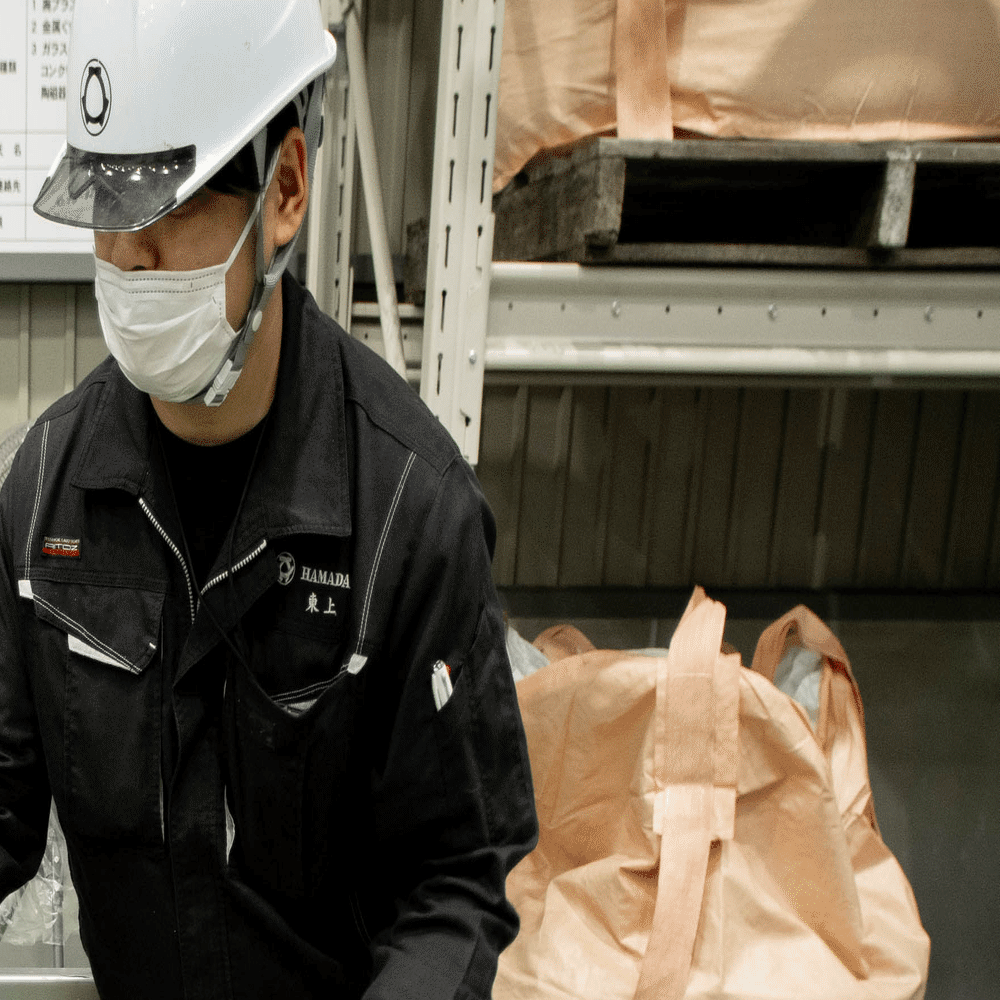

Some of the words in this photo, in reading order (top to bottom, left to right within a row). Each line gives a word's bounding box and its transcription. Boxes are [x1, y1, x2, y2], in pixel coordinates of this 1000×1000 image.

[42, 19, 72, 35] 金属く
[41, 64, 68, 78] コンク
[300, 565, 351, 589] HAMADA
